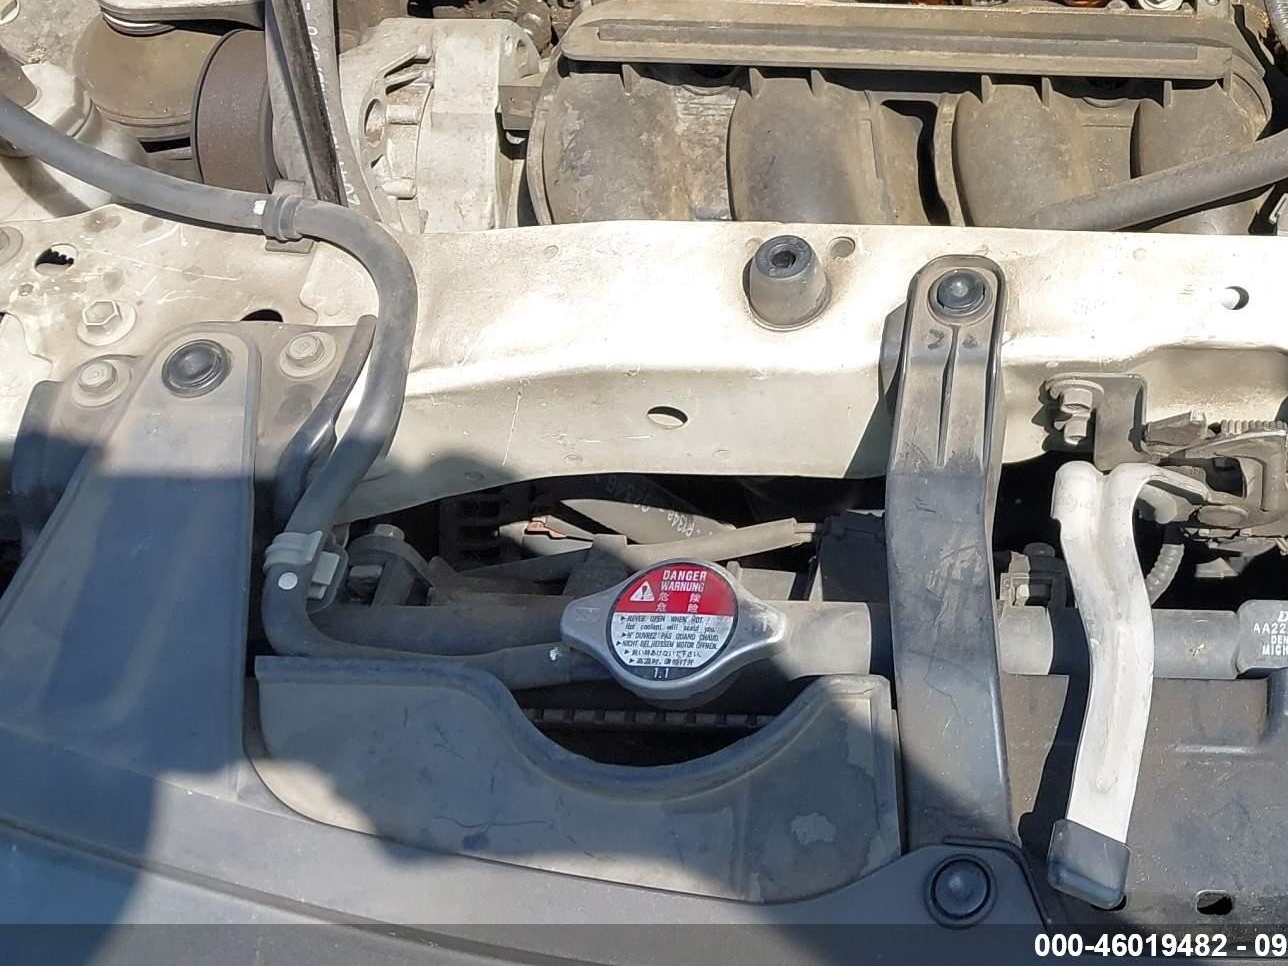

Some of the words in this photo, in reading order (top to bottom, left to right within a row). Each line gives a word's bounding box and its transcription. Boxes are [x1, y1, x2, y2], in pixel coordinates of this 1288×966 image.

[662, 570, 708, 581] DANGER
[661, 580, 705, 592] WARNUNG
[661, 632, 672, 640] PAS
[675, 633, 696, 641] QUAND
[654, 667, 669, 679] 1.1
